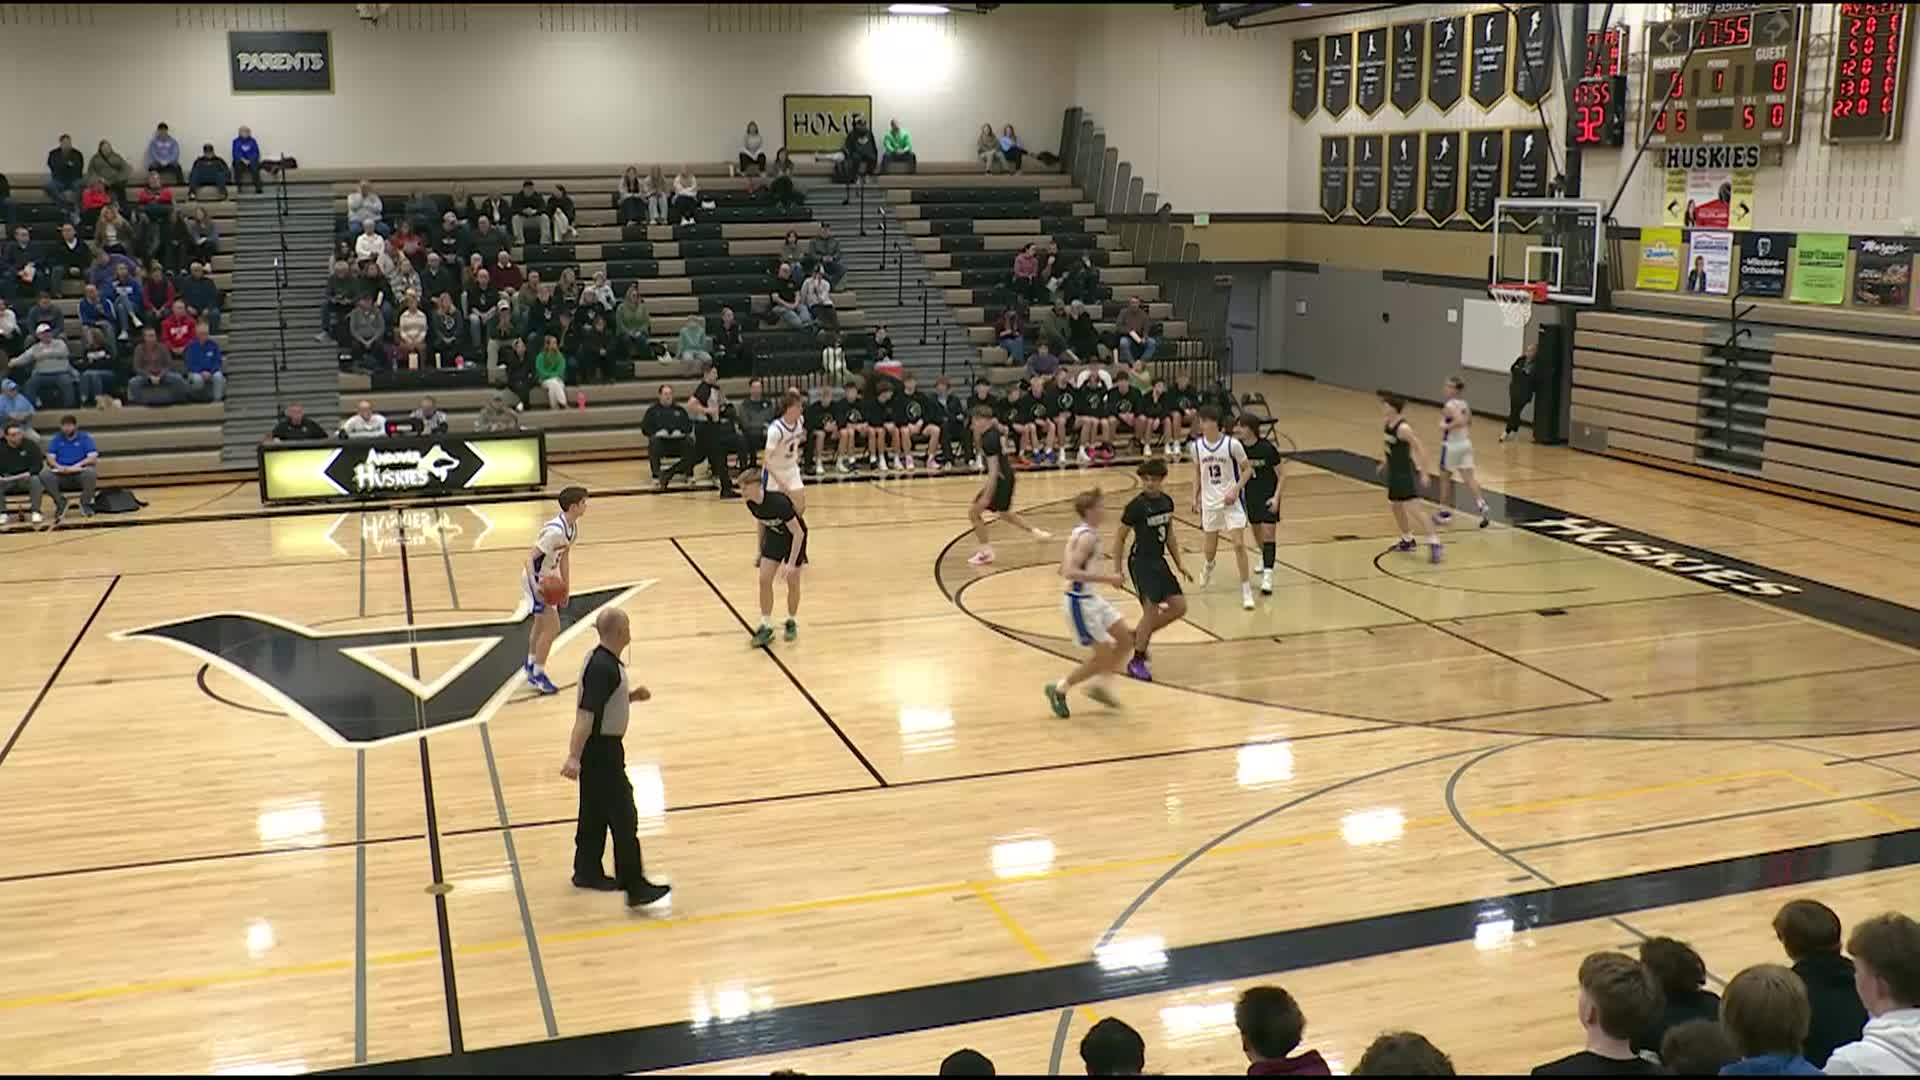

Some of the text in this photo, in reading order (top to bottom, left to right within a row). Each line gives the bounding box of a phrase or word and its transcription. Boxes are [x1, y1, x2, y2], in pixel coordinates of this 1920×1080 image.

[1851, 19, 1861, 36] 2
[237, 52, 324, 71] PARENTS
[1755, 45, 1787, 60] GUEST
[1716, 71, 1723, 89] 1
[1773, 62, 1787, 91] 0
[1743, 106, 1755, 128] 5
[1772, 104, 1784, 127] 0
[1833, 100, 1853, 117] 22
[1576, 106, 1604, 142] 32
[1675, 111, 1687, 131] 5
[1667, 146, 1759, 168] HUSKIES
[354, 463, 429, 490] HUSKIES
[1208, 465, 1221, 478] 13
[1523, 516, 1802, 596] HUSKIES
